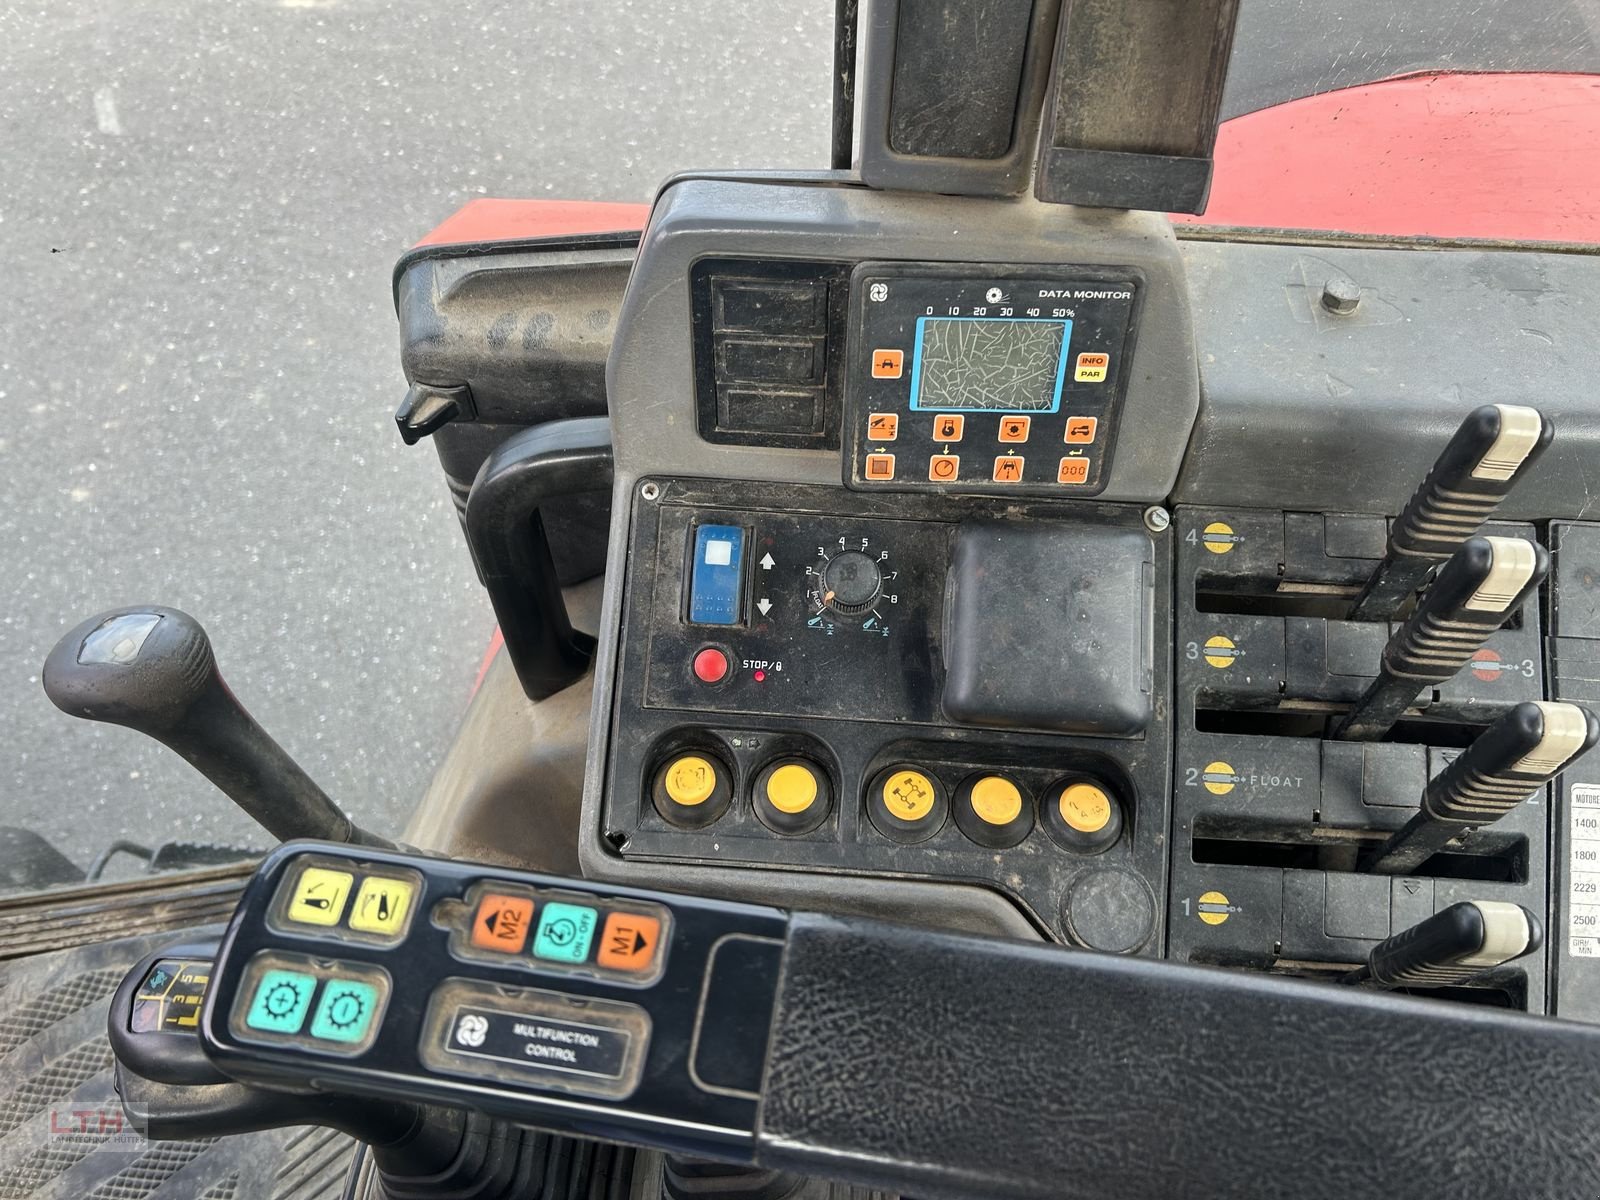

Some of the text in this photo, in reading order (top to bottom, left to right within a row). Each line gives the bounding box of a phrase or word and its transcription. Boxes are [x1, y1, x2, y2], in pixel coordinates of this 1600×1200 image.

[1038, 290, 1132, 300] DATA MONITOR
[926, 306, 1075, 318] 0 10 20 30 40 50%
[1081, 356, 1104, 365] INFO
[1080, 370, 1101, 378] PAR
[838, 536, 845, 545] 4
[1185, 528, 1198, 546] 4
[862, 538, 868, 547] 5
[818, 546, 824, 556] 3
[881, 551, 888, 560] 6
[806, 566, 812, 575] 2
[892, 572, 898, 580] 7
[890, 594, 898, 604] 8
[1186, 643, 1198, 660] 3
[1522, 660, 1535, 678] 3
[1185, 768, 1304, 788] 2 FLOAT
[1574, 818, 1597, 828] 1400
[1574, 850, 1597, 860] 1800
[1573, 882, 1596, 893] 2229
[1181, 898, 1190, 916] 1
[497, 909, 522, 940] M2
[1573, 915, 1596, 926] 2500
[610, 926, 634, 956] M1
[513, 1023, 600, 1047] MULTIFUNCTION
[525, 1043, 577, 1062] CONTROL
